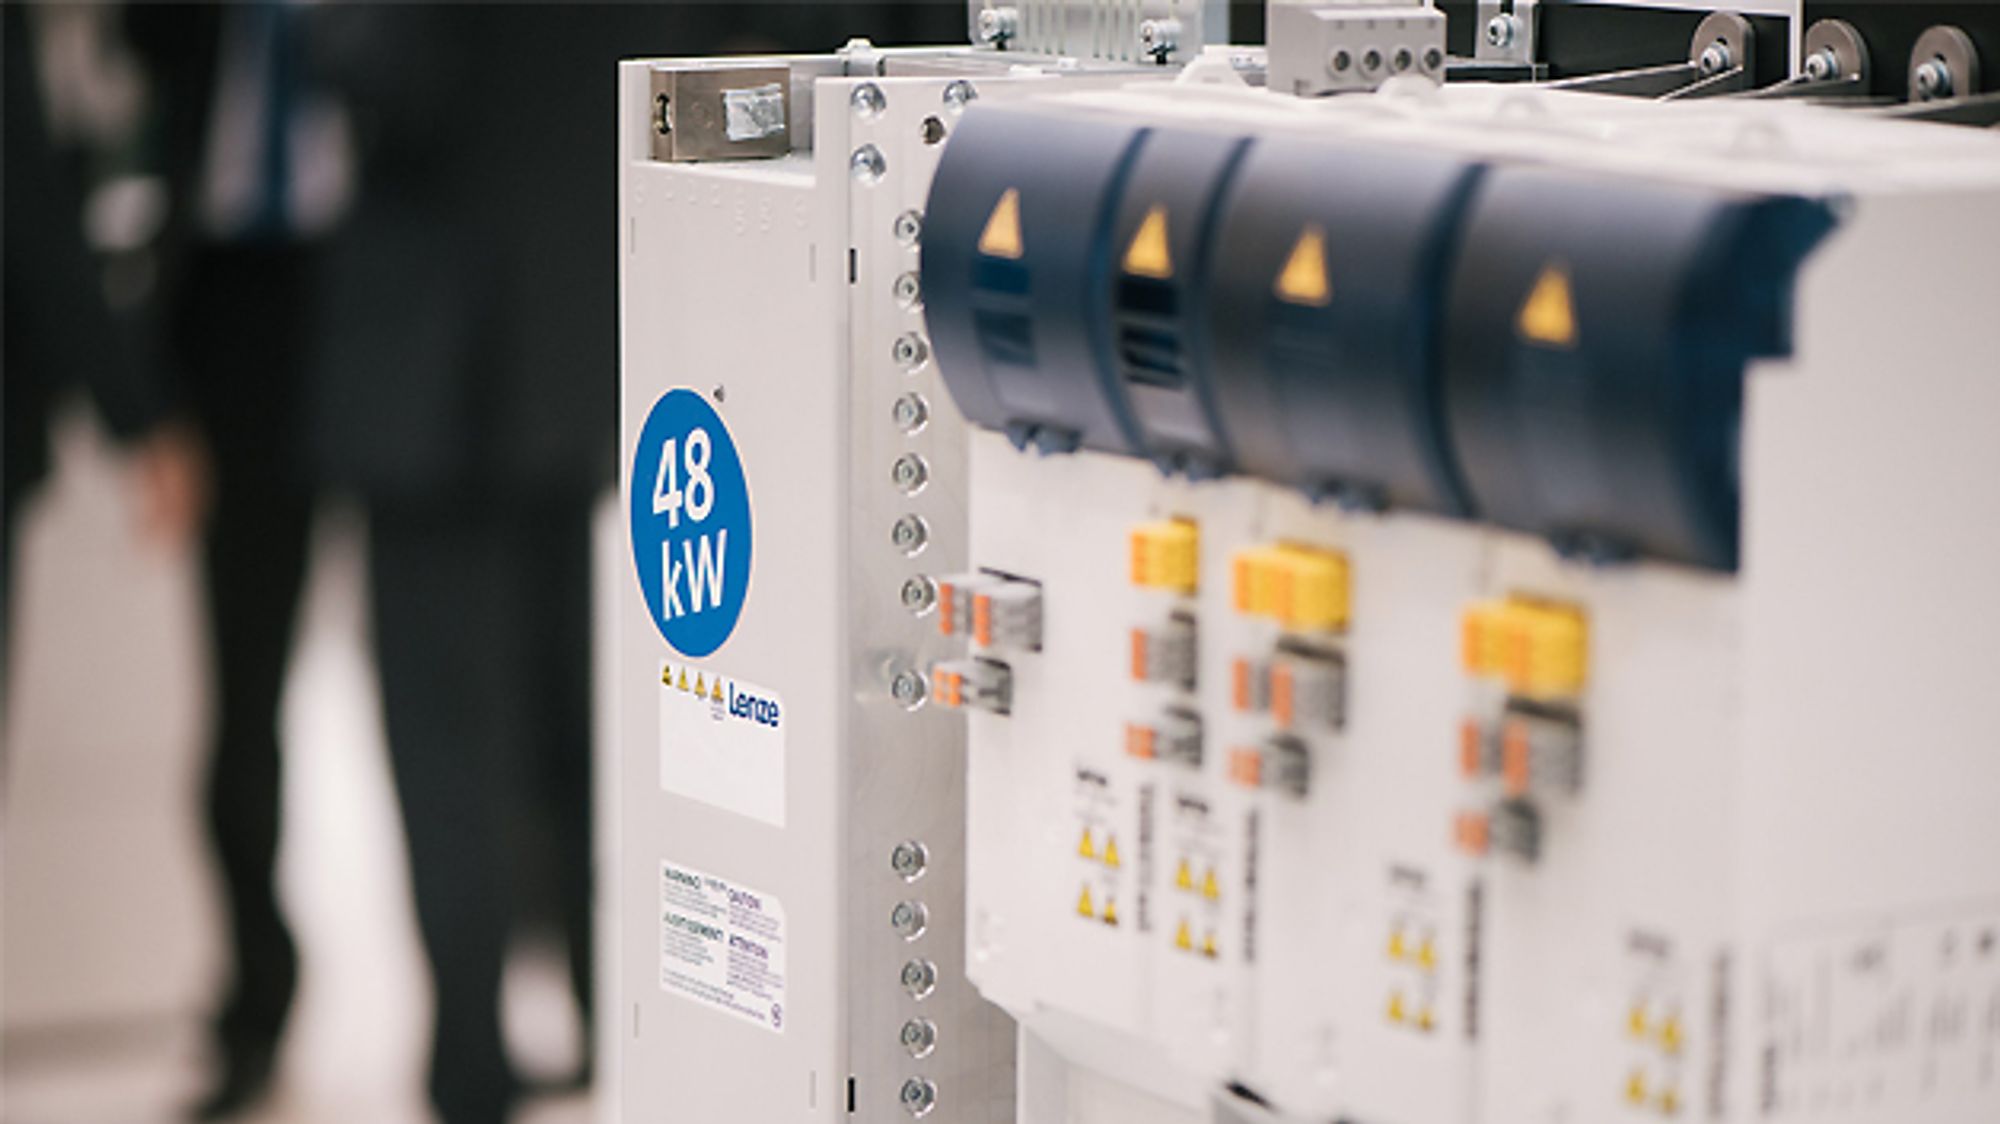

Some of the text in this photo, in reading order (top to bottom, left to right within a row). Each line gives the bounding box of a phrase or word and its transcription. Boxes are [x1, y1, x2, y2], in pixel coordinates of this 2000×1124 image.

[653, 427, 714, 529] 48
[662, 528, 728, 621] kW
[728, 680, 779, 728] Lenze
